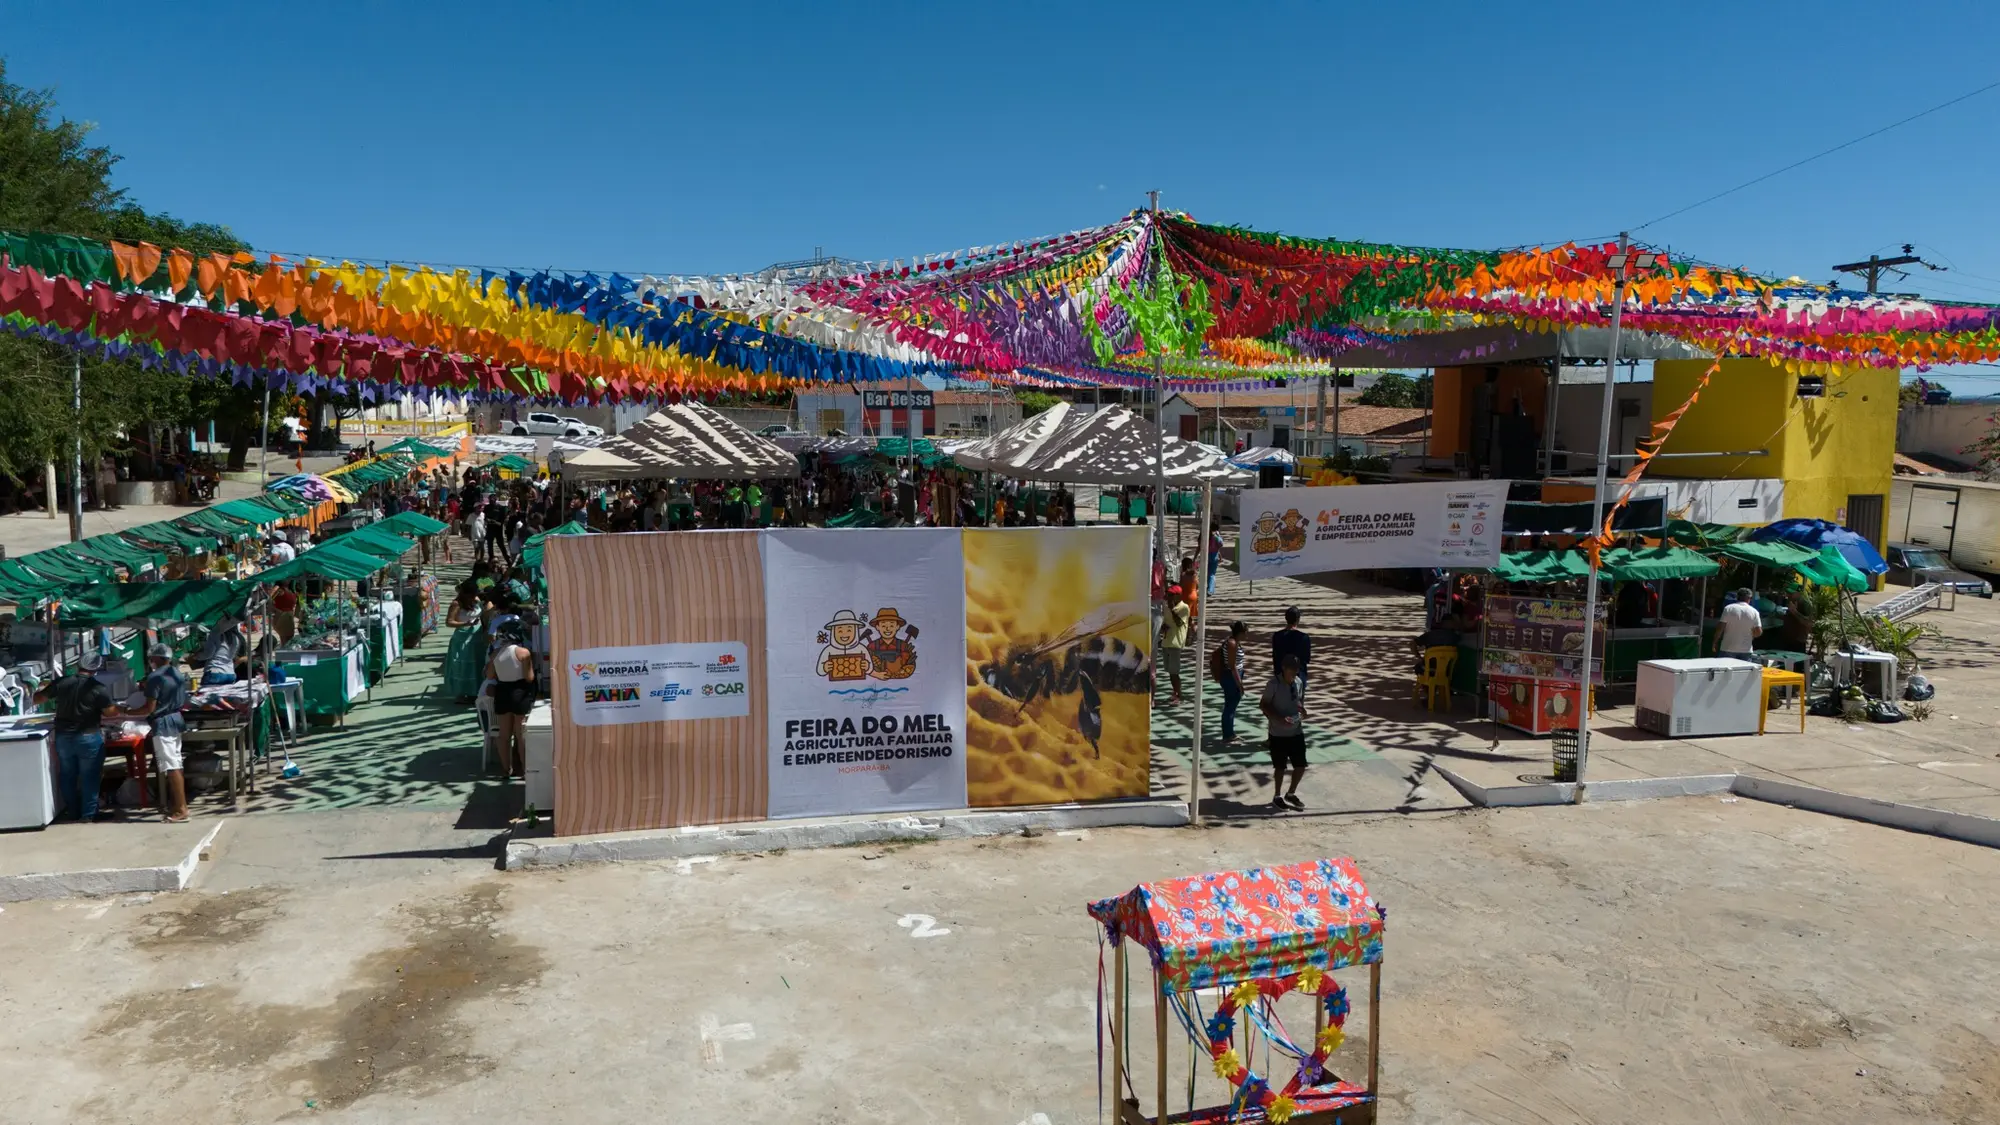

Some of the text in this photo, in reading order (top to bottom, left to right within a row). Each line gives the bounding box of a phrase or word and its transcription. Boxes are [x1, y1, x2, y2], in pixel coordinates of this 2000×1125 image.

[866, 392, 931, 406] Bar Bessa
[1338, 514, 1371, 524] FEIRA
[1374, 513, 1391, 522] DO
[1393, 512, 1416, 522] MEL
[1316, 522, 1415, 532] AGRICULTURA FAMILIAR
[1322, 530, 1414, 541] EMPREENDEDORISMO
[599, 663, 649, 675] MORPARÁ
[650, 689, 693, 697] SEBRAE
[714, 682, 744, 695] CAR
[585, 688, 640, 703] BAHIA
[786, 714, 951, 738] FEIRA DO MEL
[784, 733, 953, 751] AGRICULTURA FAMILIAR
[784, 746, 953, 766] E EMPREENDEDORISMO
[897, 913, 951, 938] 2
